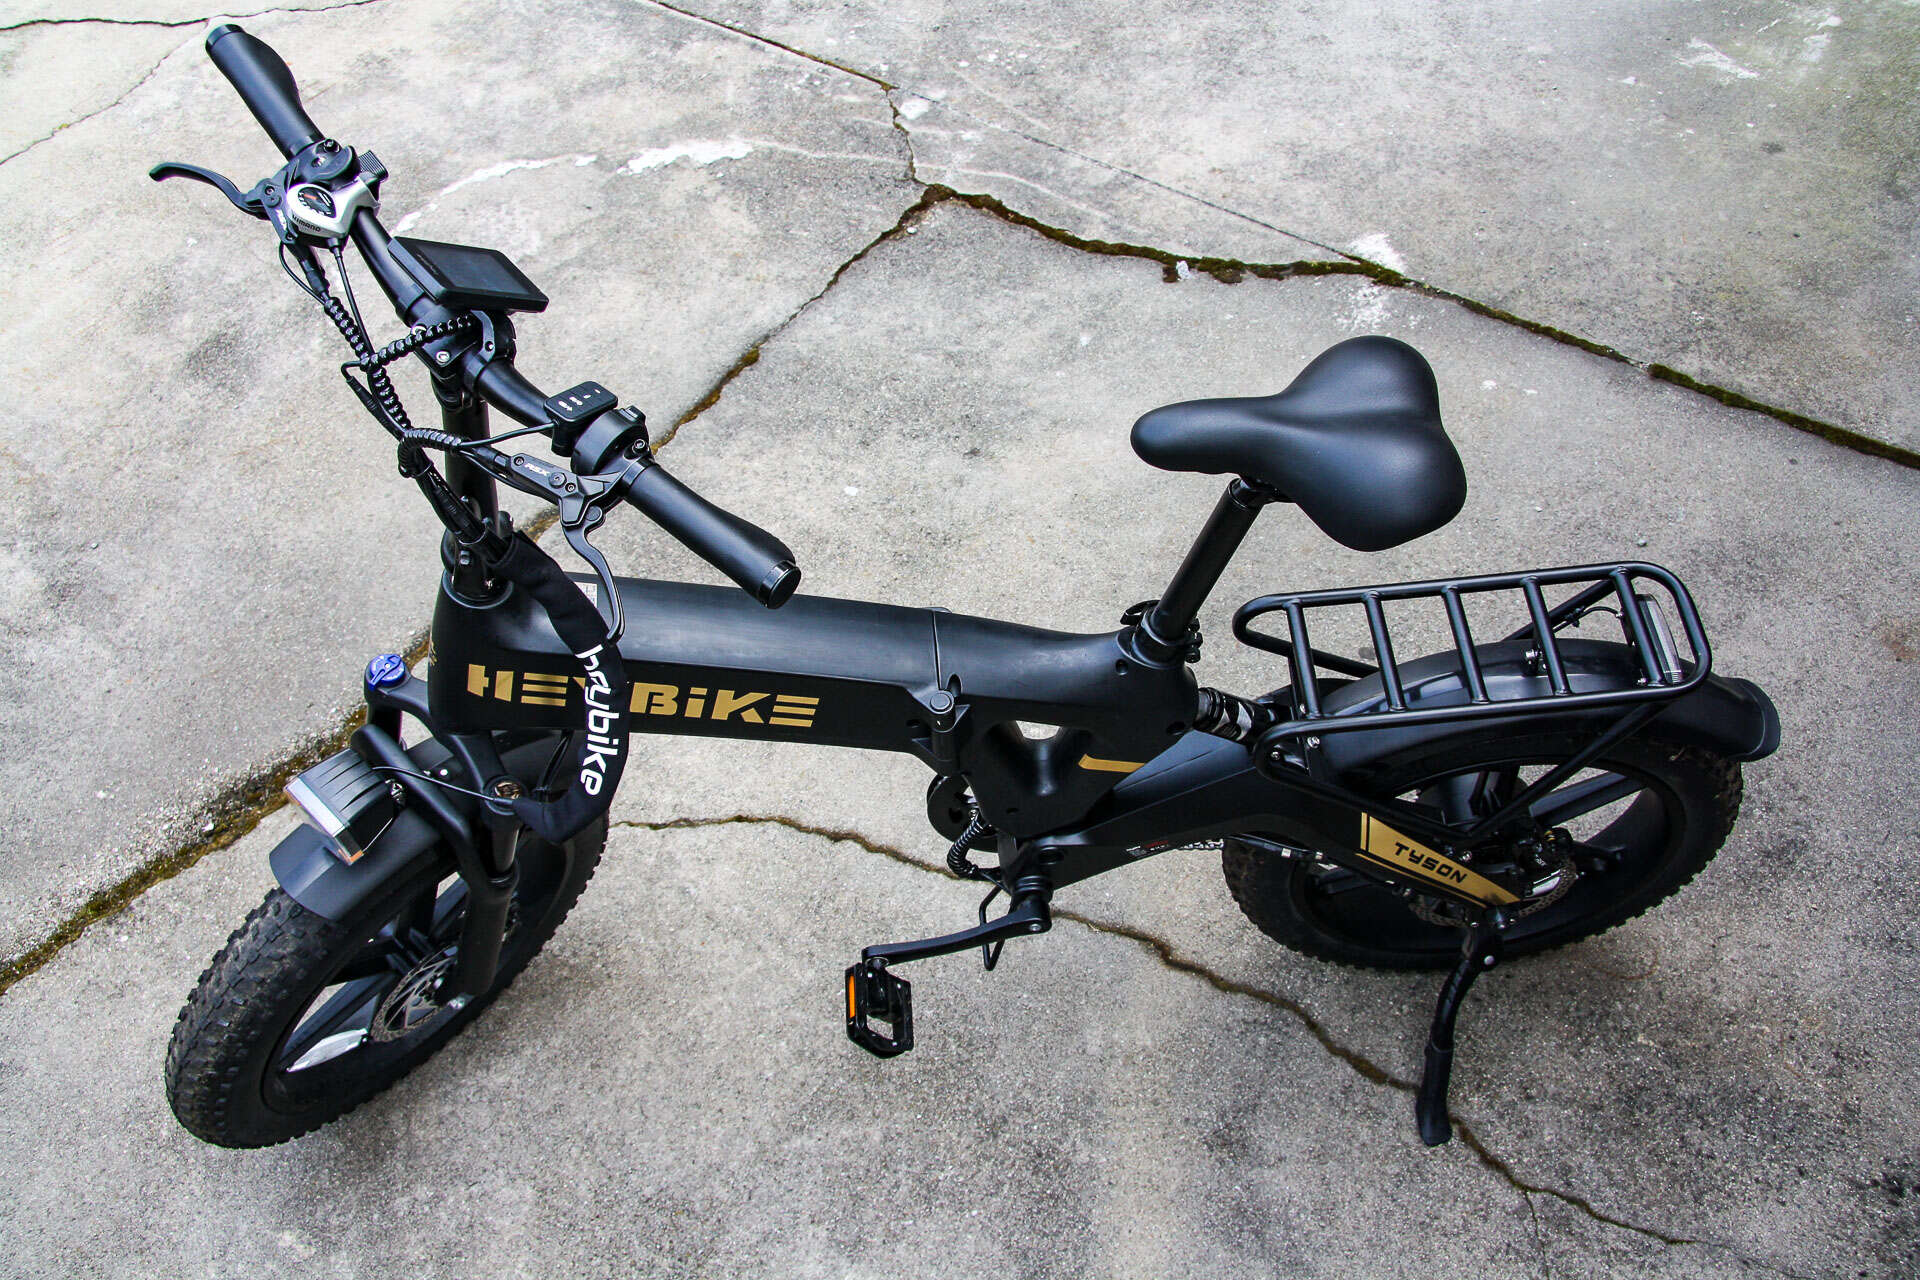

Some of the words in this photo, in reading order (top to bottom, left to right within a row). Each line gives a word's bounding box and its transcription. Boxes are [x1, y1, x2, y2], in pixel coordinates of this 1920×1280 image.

[291, 213, 321, 232] HIMANO
[467, 663, 820, 728] HEBiKE
[580, 644, 620, 796] heybike
[1394, 841, 1468, 884] TYSON
